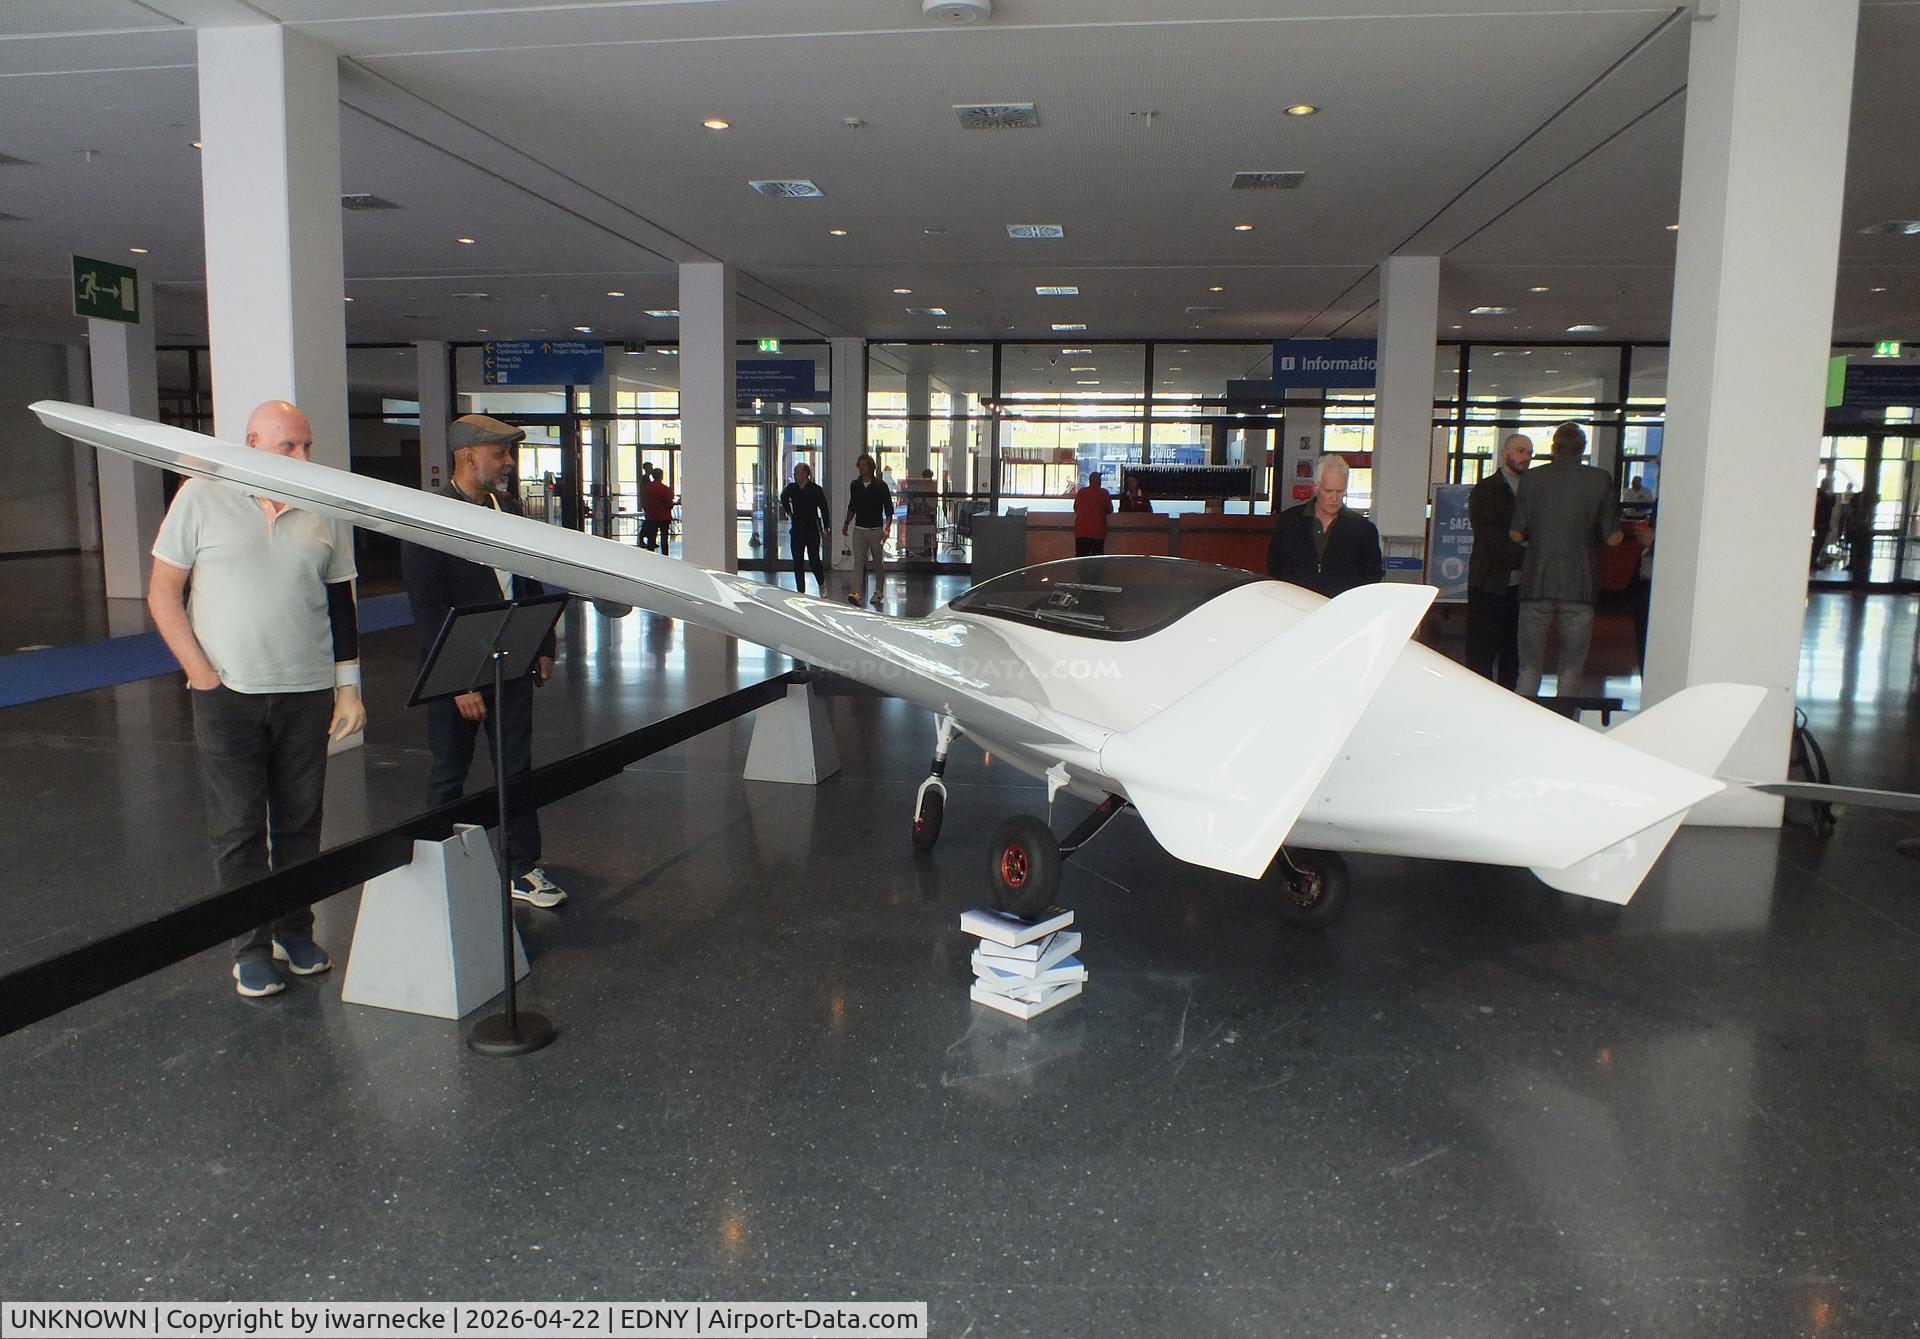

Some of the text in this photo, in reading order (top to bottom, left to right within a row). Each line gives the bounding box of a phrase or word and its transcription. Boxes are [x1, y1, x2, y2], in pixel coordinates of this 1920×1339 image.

[1302, 356, 1376, 370] Informatio
[1106, 448, 1177, 459] AERO WODWIDE
